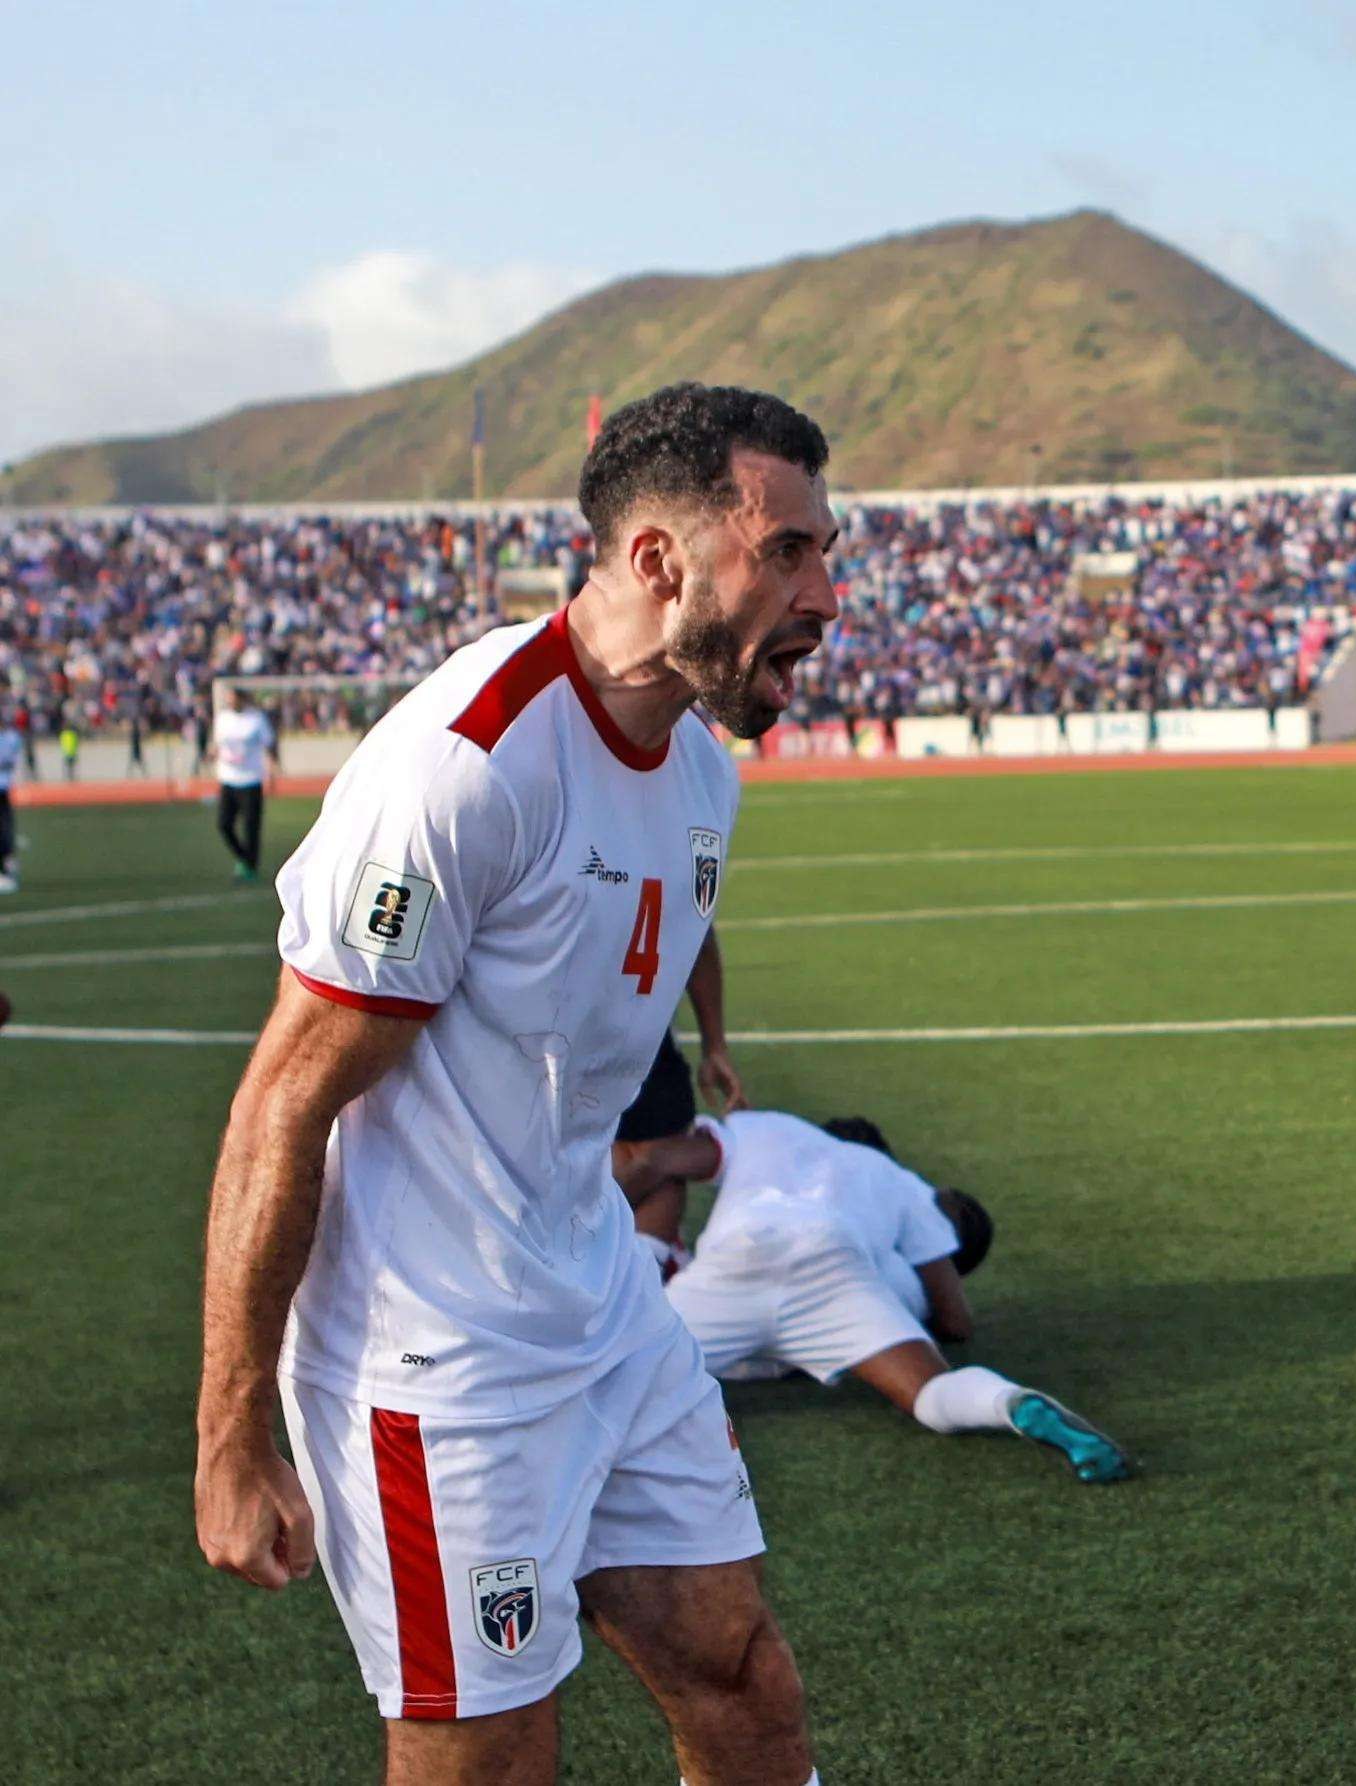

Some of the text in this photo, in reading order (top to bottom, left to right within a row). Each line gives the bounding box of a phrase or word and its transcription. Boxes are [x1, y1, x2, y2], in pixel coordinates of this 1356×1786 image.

[691, 833, 718, 848] FCF
[597, 868, 630, 885] tempo
[621, 878, 663, 995] 4
[476, 1564, 531, 1587] FCF
